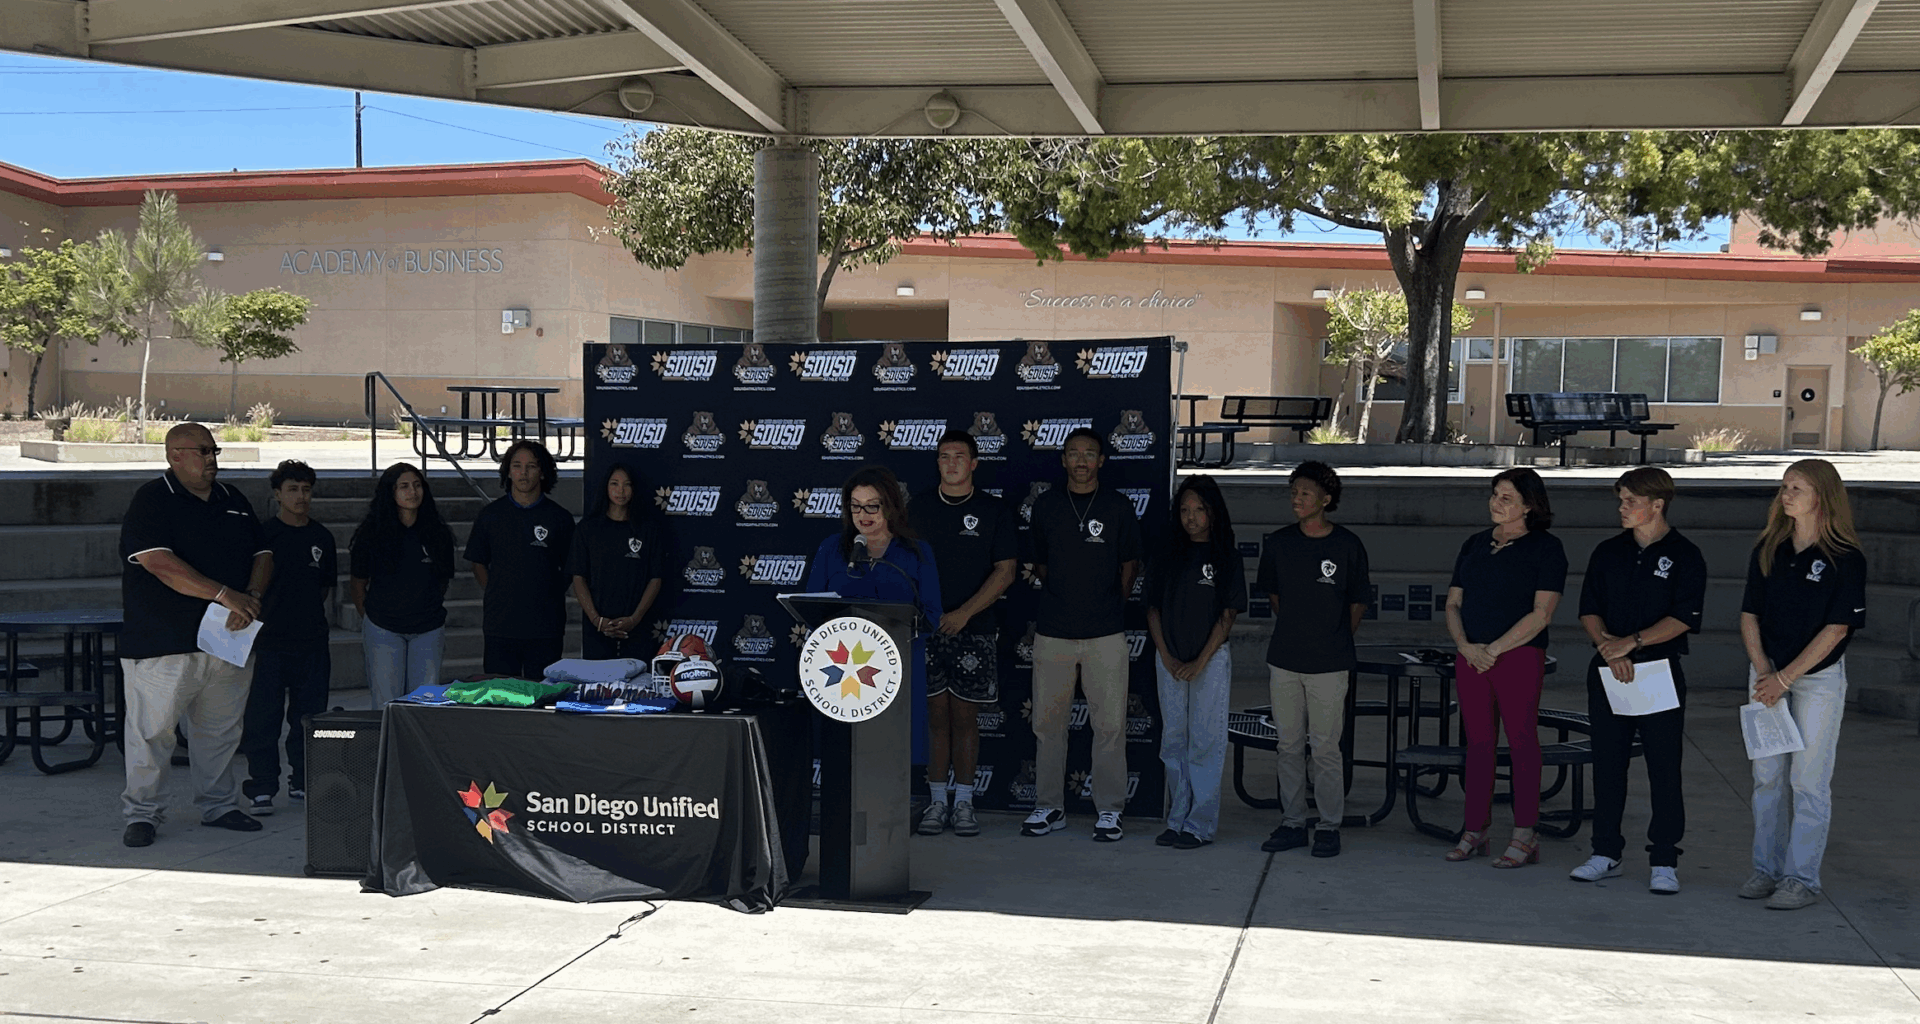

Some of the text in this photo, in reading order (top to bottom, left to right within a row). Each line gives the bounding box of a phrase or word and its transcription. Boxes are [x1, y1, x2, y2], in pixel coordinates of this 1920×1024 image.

[279, 248, 504, 275] ACADEMY of BUSINESS
[1100, 294, 1115, 309] is
[1120, 295, 1132, 308] a
[663, 355, 717, 377] SDUSD
[801, 355, 857, 377] SDUSD
[943, 354, 1000, 377] SDUSD
[1088, 351, 1148, 375] SDUSD
[612, 423, 668, 445] SDUSD
[750, 424, 806, 446] SDUSD
[666, 491, 720, 512] SDUSD
[751, 560, 806, 581] SDUSD
[803, 621, 898, 666] SAN DIEGO UNIFIED
[805, 678, 897, 718] SCHOOL DISTRICT
[525, 791, 719, 821] San Diego Unified
[526, 819, 676, 836] SCHOOL DISTRICT
